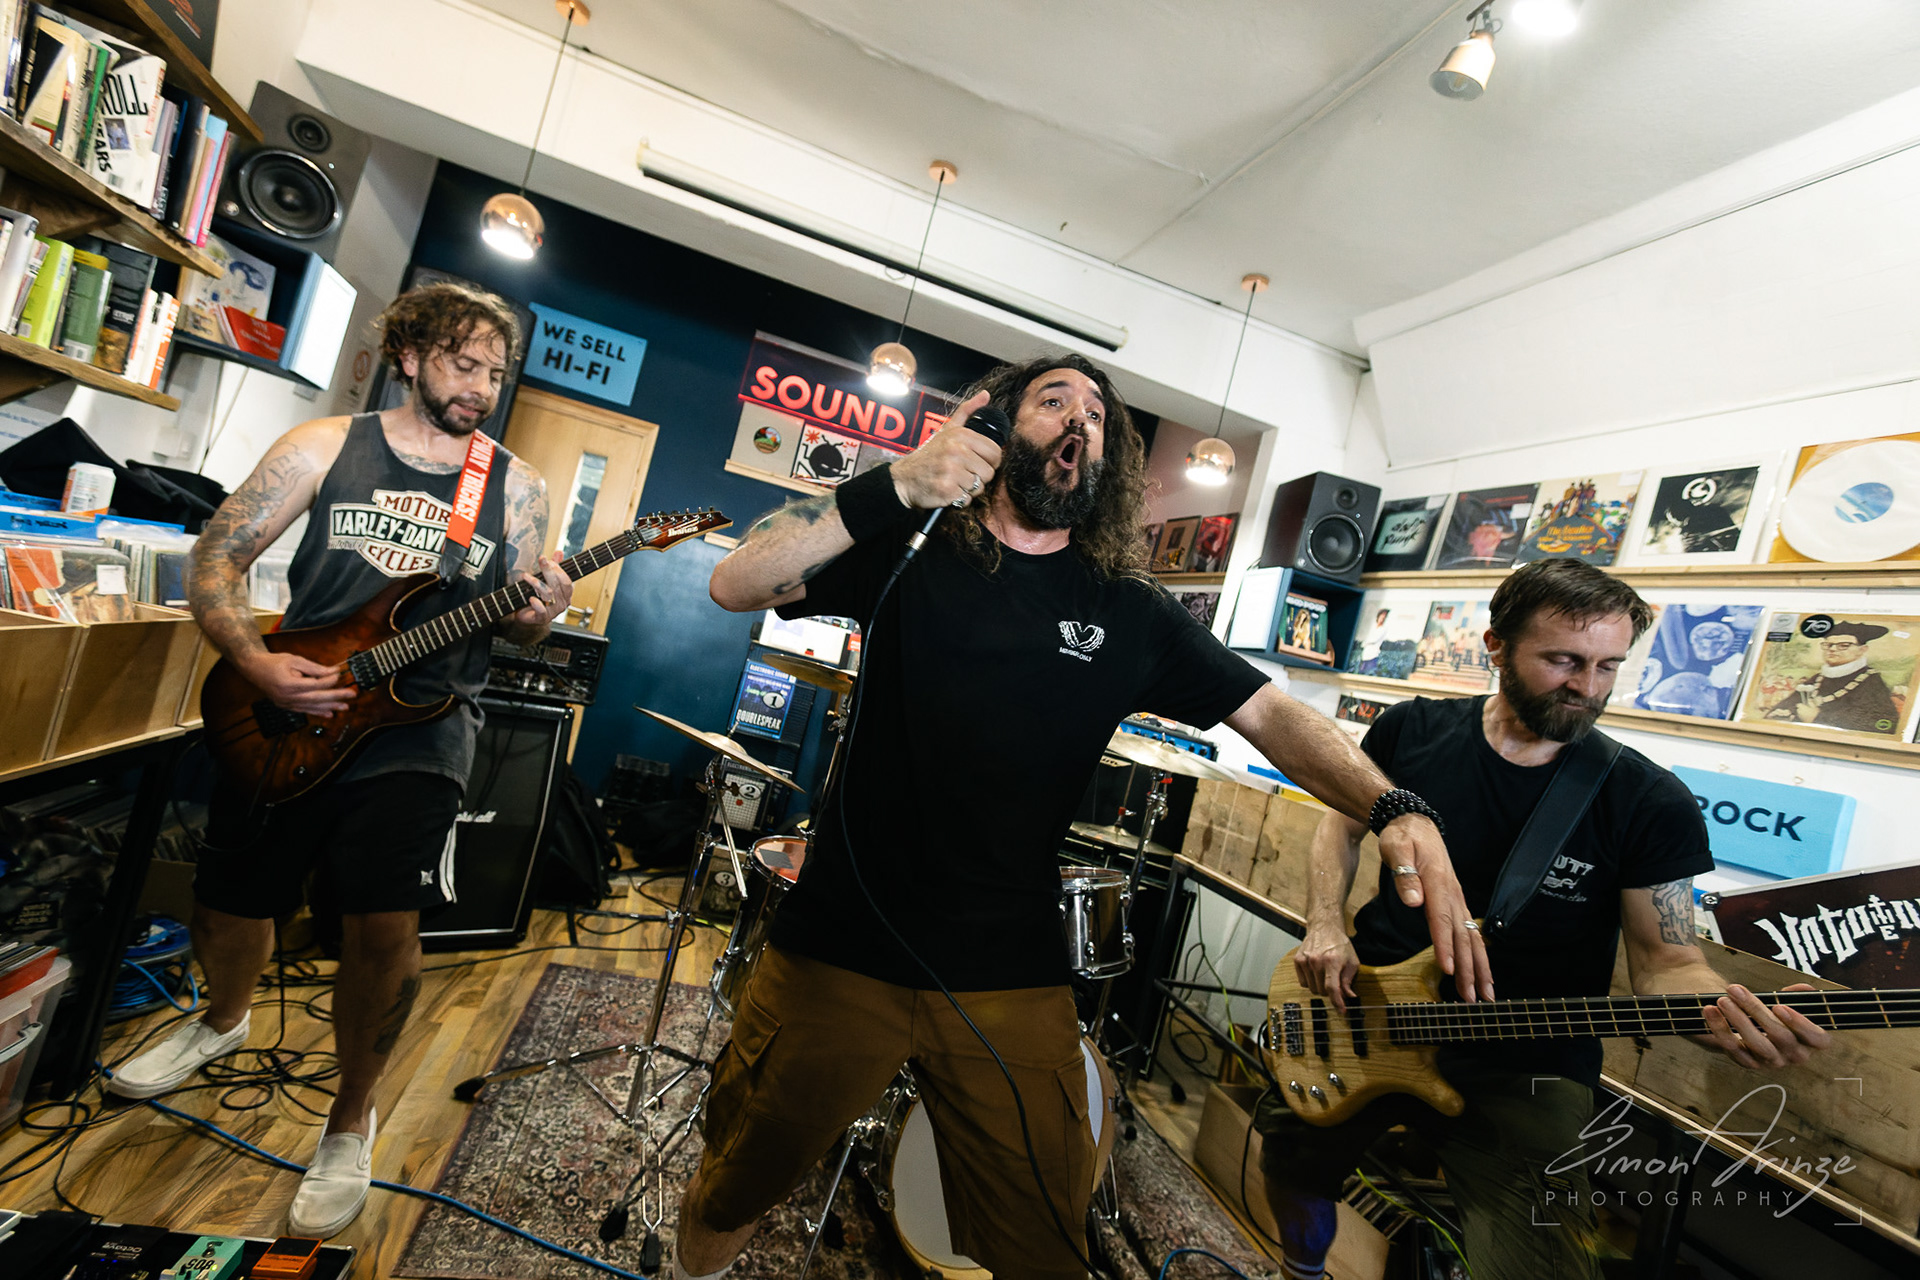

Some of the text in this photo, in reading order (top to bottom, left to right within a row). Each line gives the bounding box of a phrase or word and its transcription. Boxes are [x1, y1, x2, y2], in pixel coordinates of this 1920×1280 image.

[94, 122, 113, 172] EARS
[543, 320, 626, 362] WE SELL
[543, 347, 611, 385] HI-FI
[751, 365, 906, 440] SOUND
[384, 495, 451, 523] MOTOR
[368, 544, 434, 572] CYCLES
[769, 695, 777, 708] 1
[736, 709, 782, 730] DOUBLESPEAK
[743, 786, 756, 798] 2
[720, 874, 730, 885] 3
